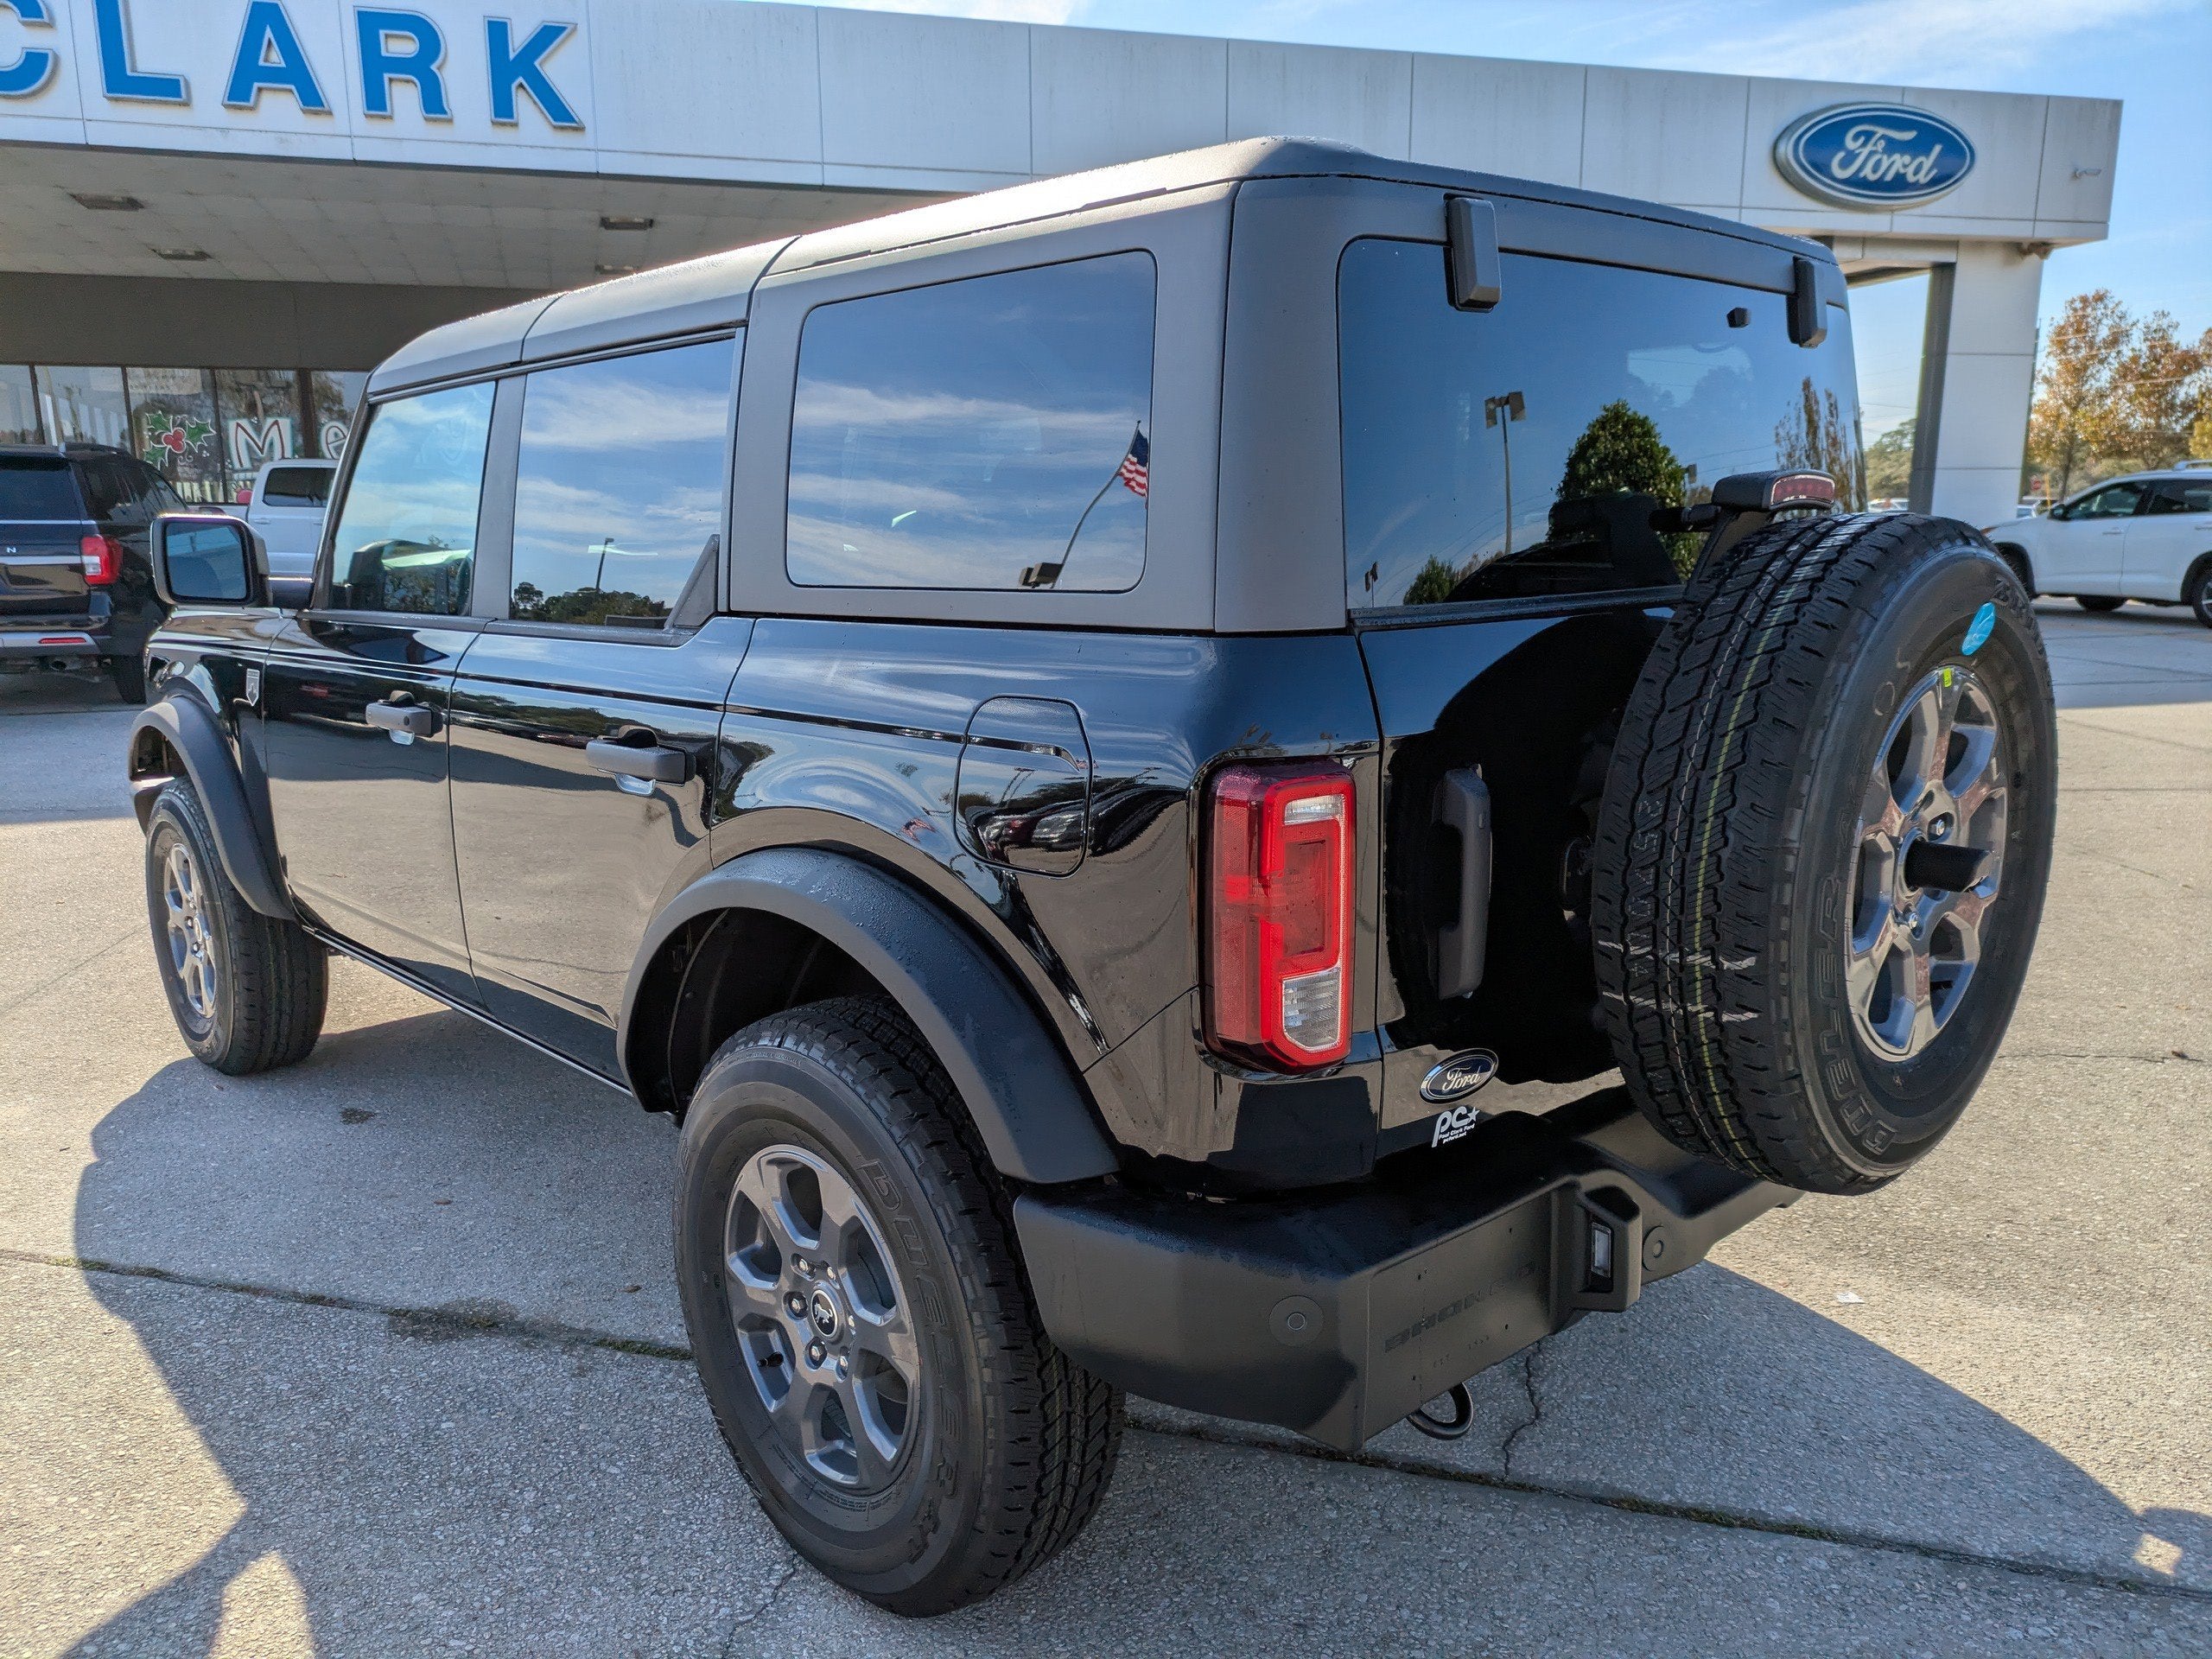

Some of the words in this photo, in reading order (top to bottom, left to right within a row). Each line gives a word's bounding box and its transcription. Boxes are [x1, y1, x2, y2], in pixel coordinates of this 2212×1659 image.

[1830, 124, 1943, 185] Ford
[1441, 1065, 1482, 1092] Ford
[1463, 1122, 1476, 1131] Ford
